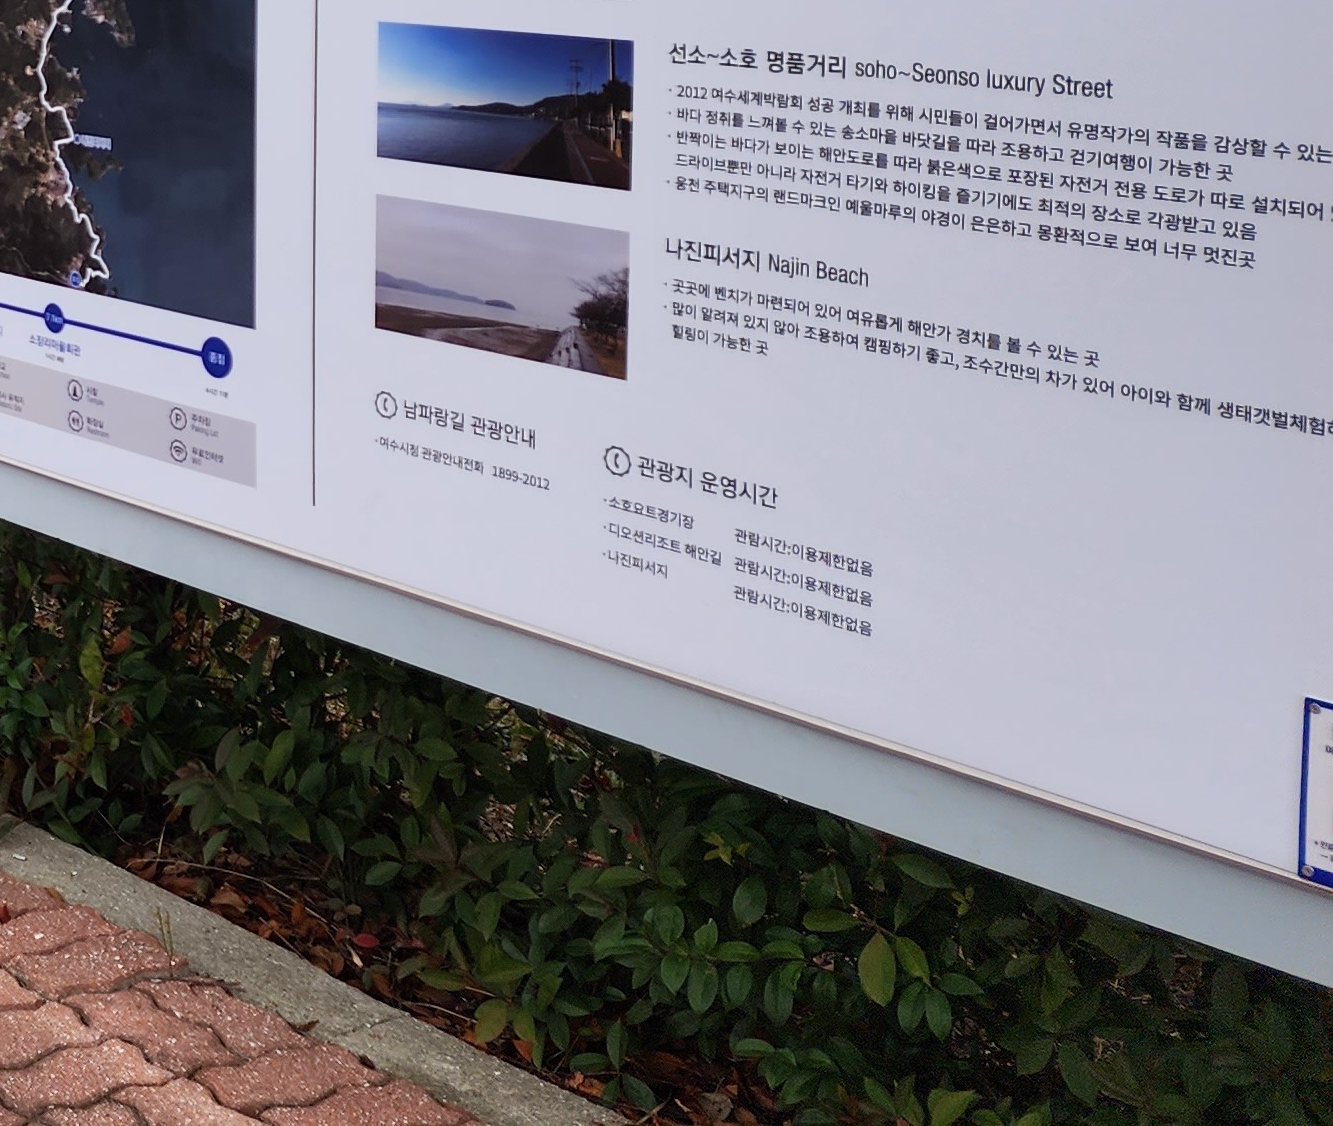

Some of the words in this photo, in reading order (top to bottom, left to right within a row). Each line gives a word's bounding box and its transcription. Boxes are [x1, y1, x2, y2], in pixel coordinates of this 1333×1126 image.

[766, 50, 847, 81] 명품거리
[986, 67, 1046, 98] luxury
[1052, 73, 1114, 100] Street
[676, 84, 708, 101] 2012
[710, 86, 803, 112] 여수세계박람회
[807, 96, 835, 114] 성공
[838, 99, 882, 119] 개최를
[884, 103, 914, 123] 위해
[918, 107, 978, 130] 시민들이
[983, 113, 1062, 139] 걸어가면서
[1066, 121, 1150, 147] 유명작가의
[1155, 130, 1209, 152] 작품을
[1213, 135, 1268, 158] 감상할
[676, 106, 703, 125] 바다
[704, 109, 745, 129] 정취를
[809, 120, 838, 139] 있는
[902, 130, 962, 153] 바닷길을
[965, 137, 998, 158] 따라
[1000, 141, 1065, 163] 조용하고
[1158, 157, 1212, 180] 가능한
[676, 129, 728, 150] 반짝이는
[730, 136, 771, 156] 바다가
[773, 141, 815, 161] 보이는
[817, 145, 890, 170] 해안도로를
[893, 154, 923, 175] 따라
[926, 158, 1003, 182] 붉은색으로
[1006, 168, 1054, 190] 포장된
[1058, 174, 1108, 197] 자전거
[1113, 180, 1148, 201] 전용
[1152, 184, 1206, 208] 도로가
[1210, 191, 1246, 211] 따로
[1251, 195, 1324, 222] 설치되어
[756, 162, 798, 184] 아니라
[799, 168, 842, 189] 자전거
[846, 173, 889, 195] 타기와
[892, 179, 952, 203] 하이킹을
[955, 187, 1034, 212] 즐기기에도
[1037, 197, 1086, 221] 최적의
[1090, 204, 1142, 226] 장소로
[1146, 211, 1217, 235] 각광받고
[1222, 220, 1258, 242] 있음
[703, 179, 769, 203] 주택지구의
[845, 198, 917, 224] 예울마루의
[921, 208, 966, 231] 야경이
[969, 215, 1033, 238] 은은하고
[1036, 223, 1119, 250] 몽환적으로
[1123, 235, 1158, 257] 보여
[1163, 241, 1198, 262] 너무
[1203, 246, 1257, 270] 멋진곳
[665, 237, 761, 274] 나진피서지
[768, 252, 810, 279] Najin
[816, 260, 869, 288] Beach
[671, 278, 711, 300] 곳곳에
[756, 293, 810, 318] 마련되어
[814, 303, 842, 323] 있어
[846, 308, 903, 334] 여유롭게
[907, 319, 952, 343] 해안가
[955, 327, 1002, 352] 경치를
[1047, 343, 1080, 365] 있는
[712, 332, 752, 354] 가능한
[672, 301, 697, 321] 많이
[700, 306, 739, 329] 알려져
[743, 314, 769, 334] 있지
[803, 325, 859, 351] 조용하여
[863, 335, 921, 363] 캠핑하기
[925, 346, 960, 371] 좋고,
[962, 354, 1040, 385] 조수간만의
[1044, 369, 1078, 391] 차가
[1082, 376, 1115, 399] 있어
[1120, 383, 1173, 409] 아이와
[1176, 392, 1211, 417] 함께
[403, 399, 465, 433] 남파랑길
[469, 415, 536, 451] 관광안내
[491, 465, 550, 491] 1899-2012
[636, 455, 693, 490] 관광지
[698, 471, 779, 510] 운영시간
[608, 496, 695, 530] 소호요트경기장
[607, 549, 668, 580] 나진피서지
[683, 543, 722, 567] 해안길
